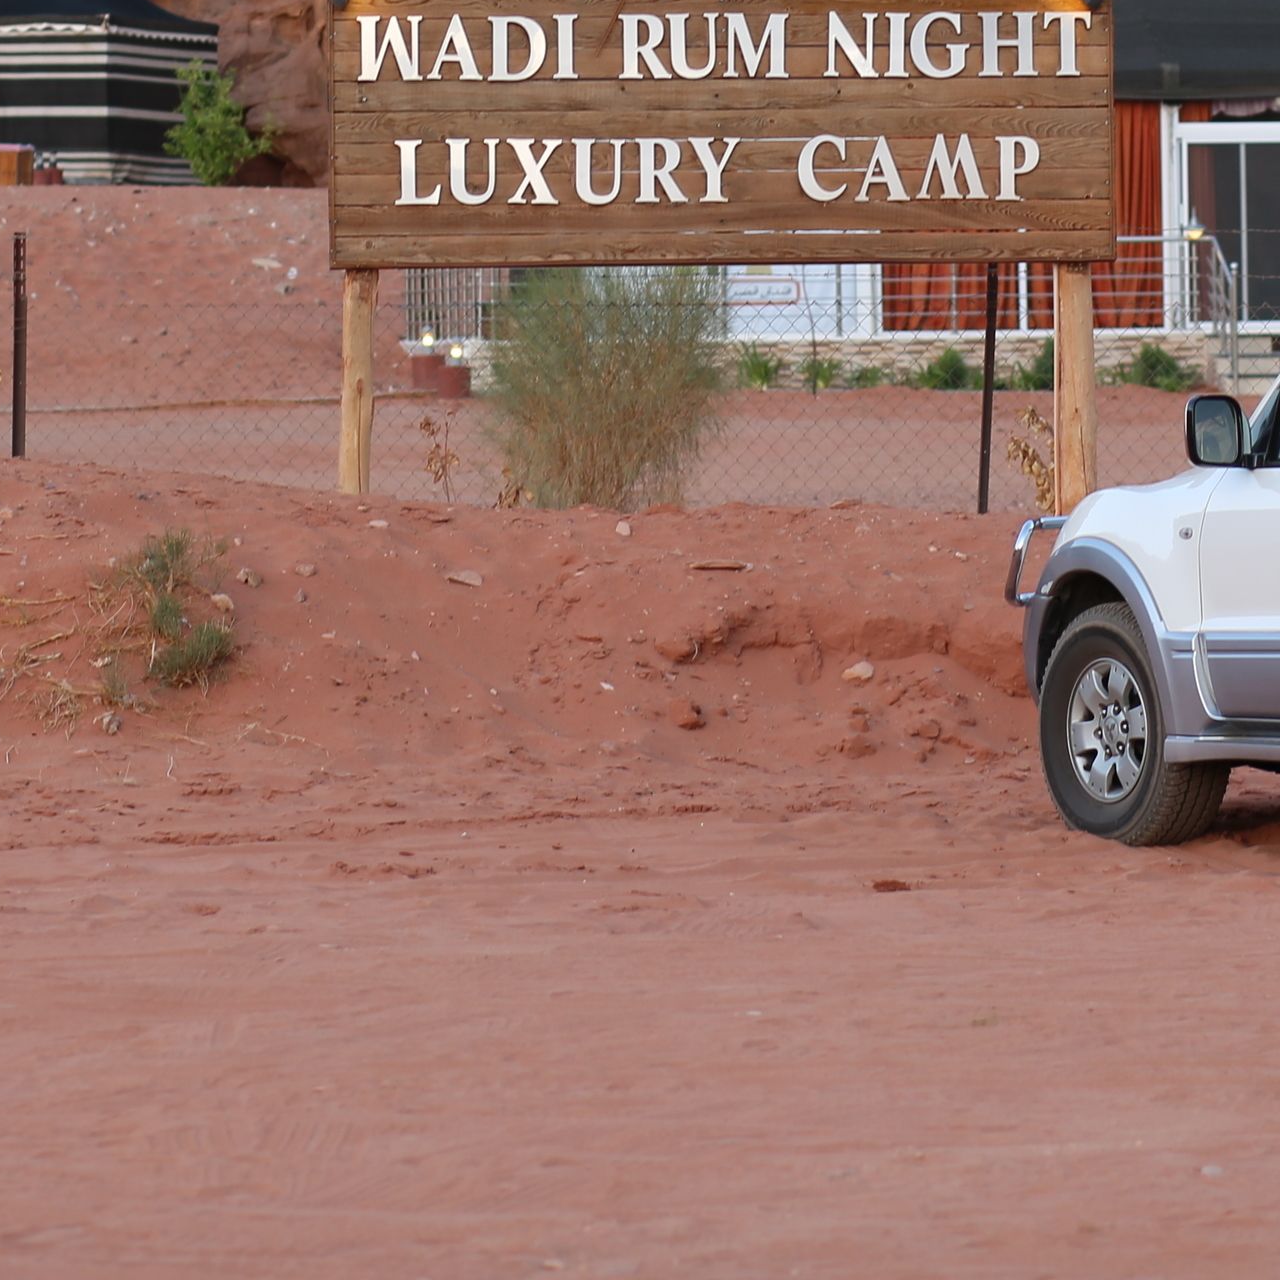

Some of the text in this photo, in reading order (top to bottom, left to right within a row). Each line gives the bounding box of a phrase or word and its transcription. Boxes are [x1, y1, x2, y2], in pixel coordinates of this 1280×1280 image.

[356, 10, 1092, 81] WADI RUM NIGHT
[394, 132, 1040, 206] LUXURY CAMP
